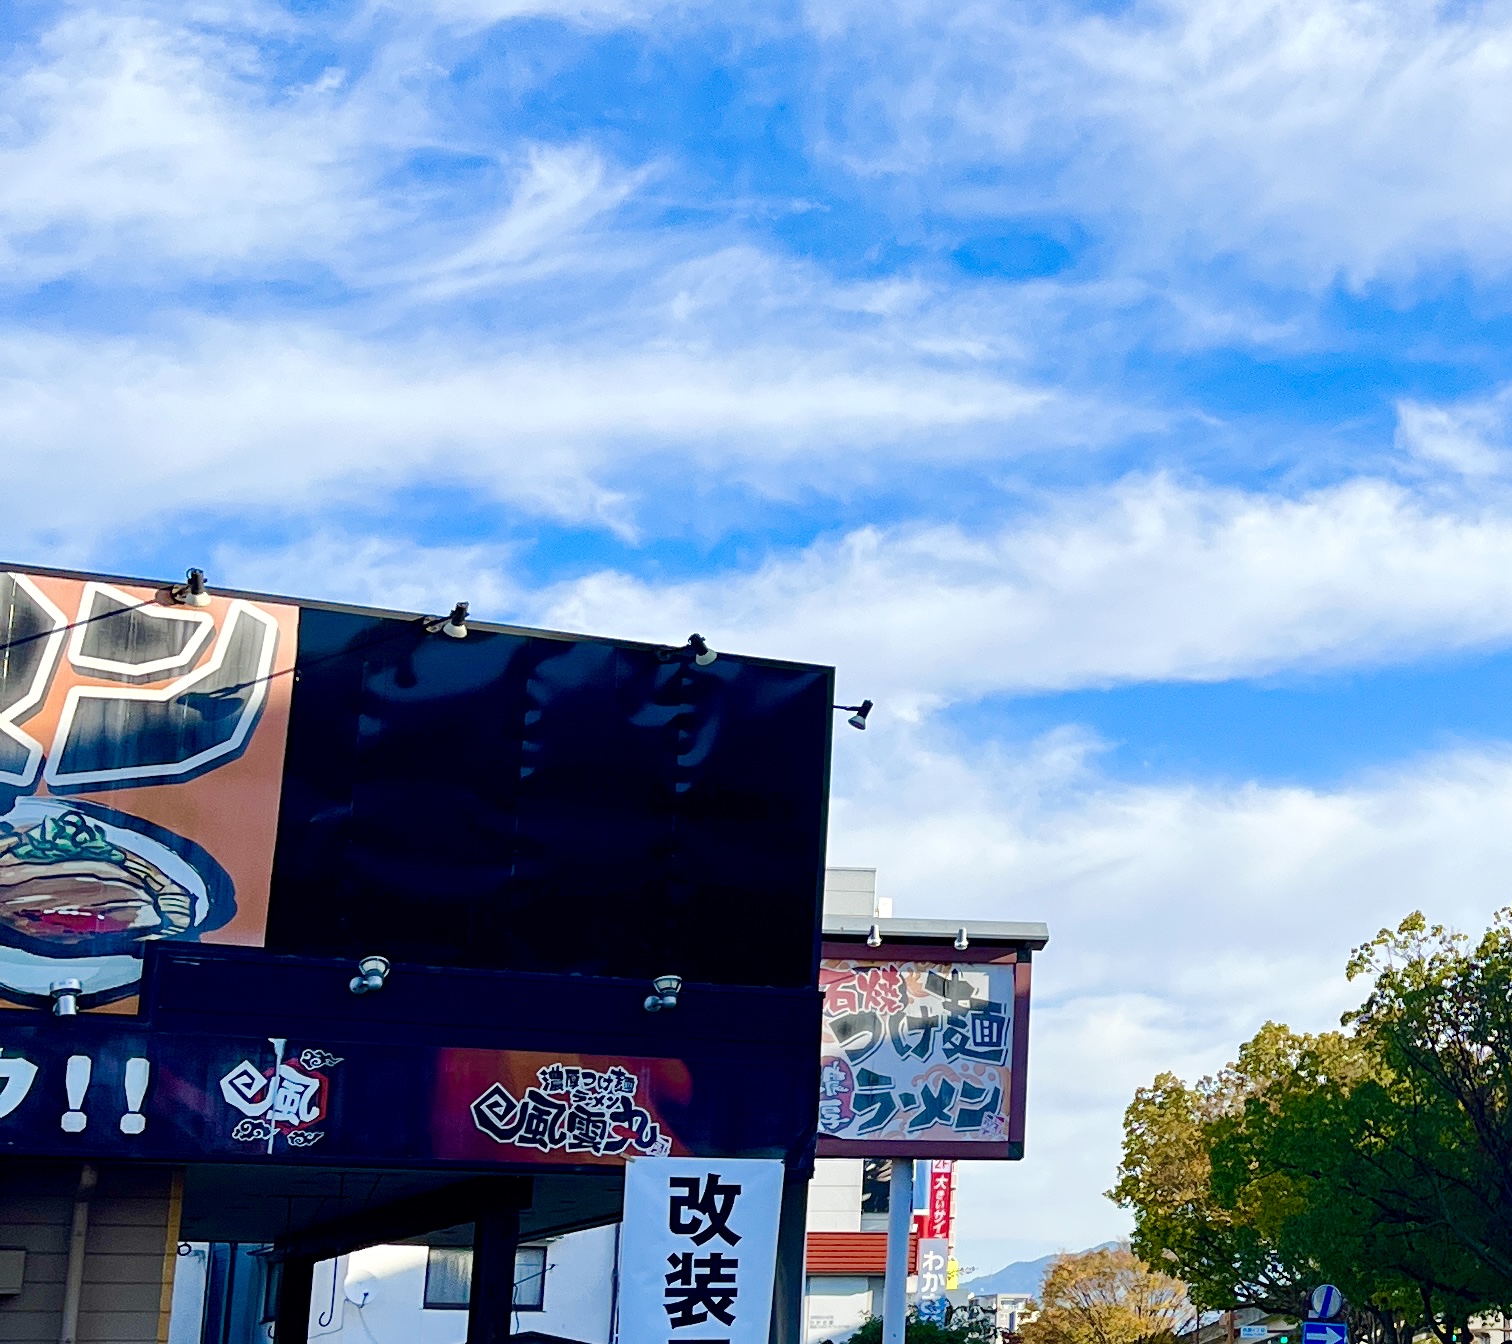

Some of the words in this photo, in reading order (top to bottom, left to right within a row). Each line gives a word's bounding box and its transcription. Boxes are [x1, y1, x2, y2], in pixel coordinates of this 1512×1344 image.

[828, 968, 1006, 1065] つけ麺
[537, 1064, 638, 1094] 濃厚つけ麺
[850, 1067, 1002, 1135] ラーメン
